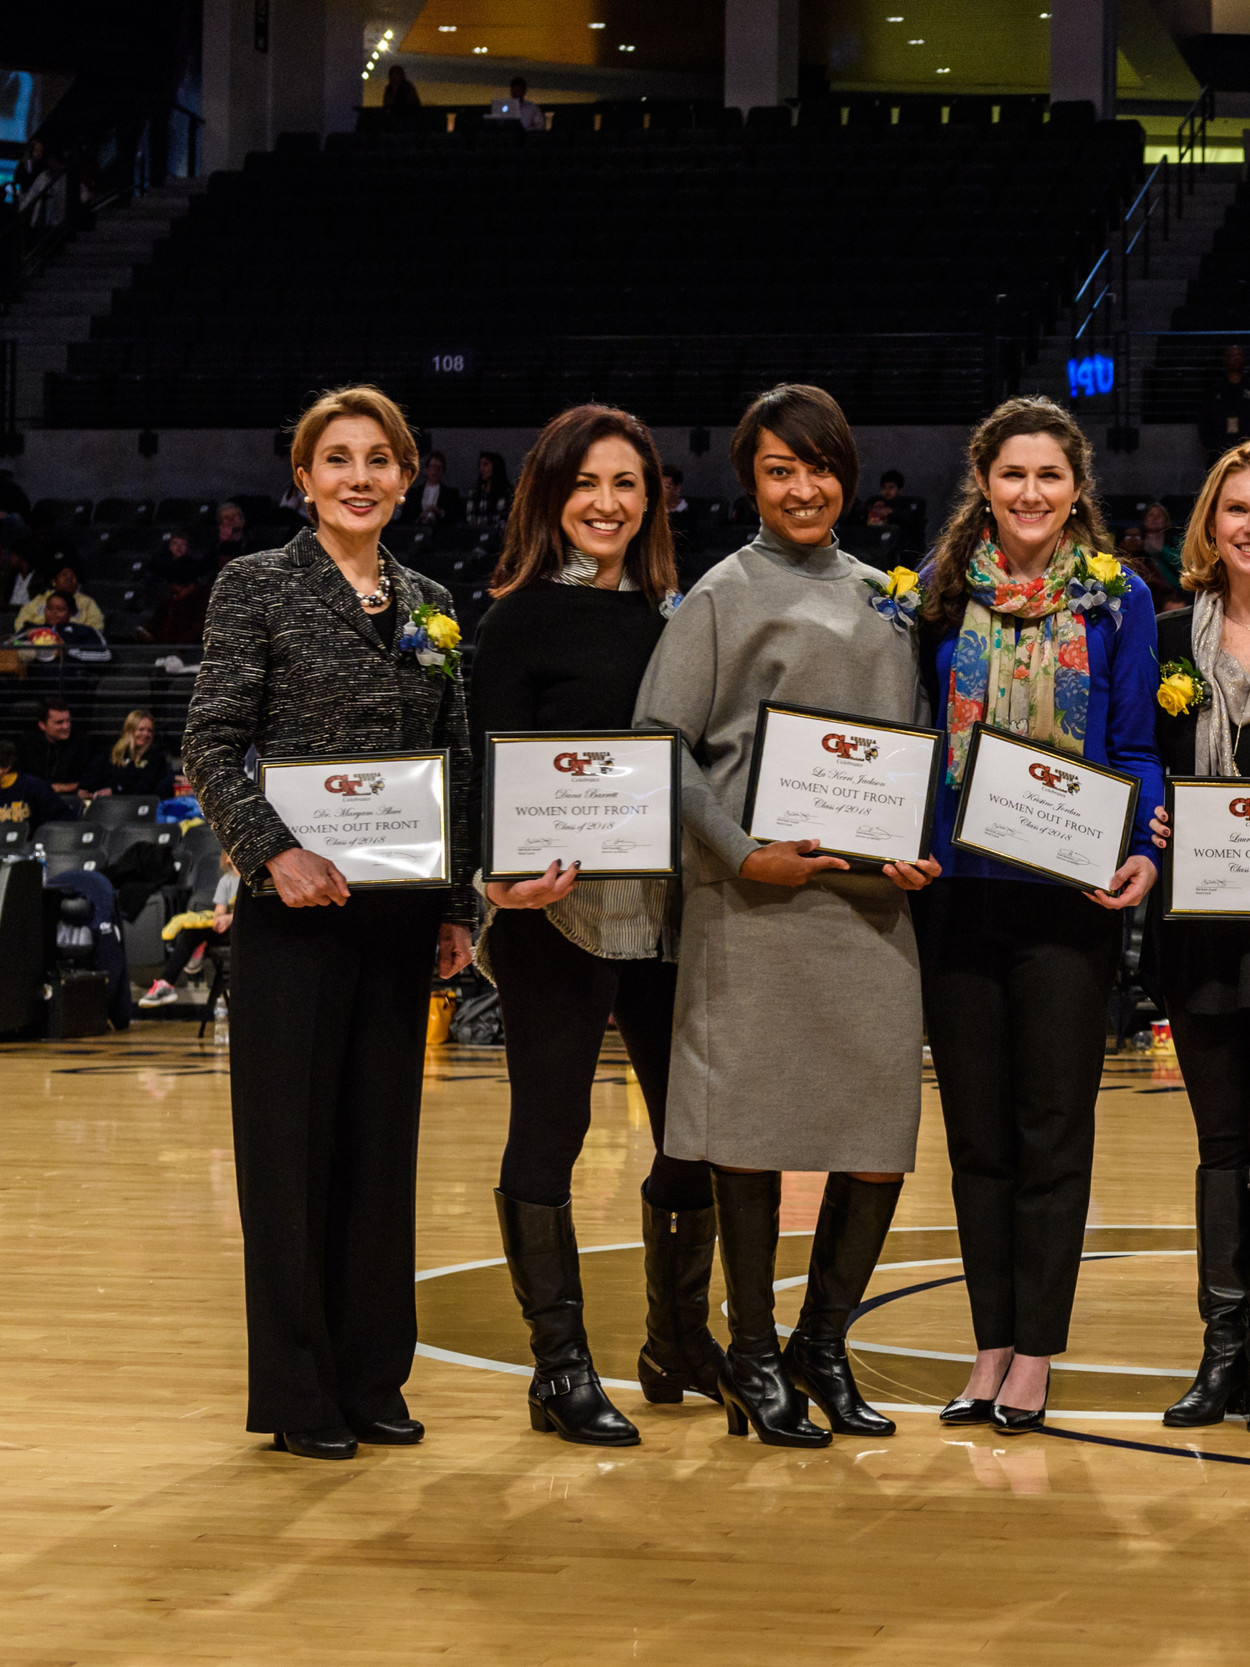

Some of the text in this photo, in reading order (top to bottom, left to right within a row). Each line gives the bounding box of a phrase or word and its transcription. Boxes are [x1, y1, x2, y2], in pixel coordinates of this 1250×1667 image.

[432, 355, 464, 371] 108
[780, 778, 906, 807] WOMEN OUT FRONT
[515, 805, 649, 816] WOMEN OUT FRONT
[813, 797, 872, 816] Class of 2018
[1052, 802, 1081, 817] Jordan
[313, 809, 331, 819] Dr.
[989, 794, 1104, 839] WOMEN OUT FRONT
[288, 820, 420, 834] WOMEN OUT FRONT
[553, 820, 615, 833] Class of 2018
[1019, 816, 1038, 831] Class
[1038, 823, 1048, 834] of
[1047, 827, 1073, 841] 2018
[324, 835, 387, 847] Class of 2018
[1194, 848, 1242, 859] WOMEN
[1228, 862, 1250, 873] Class
